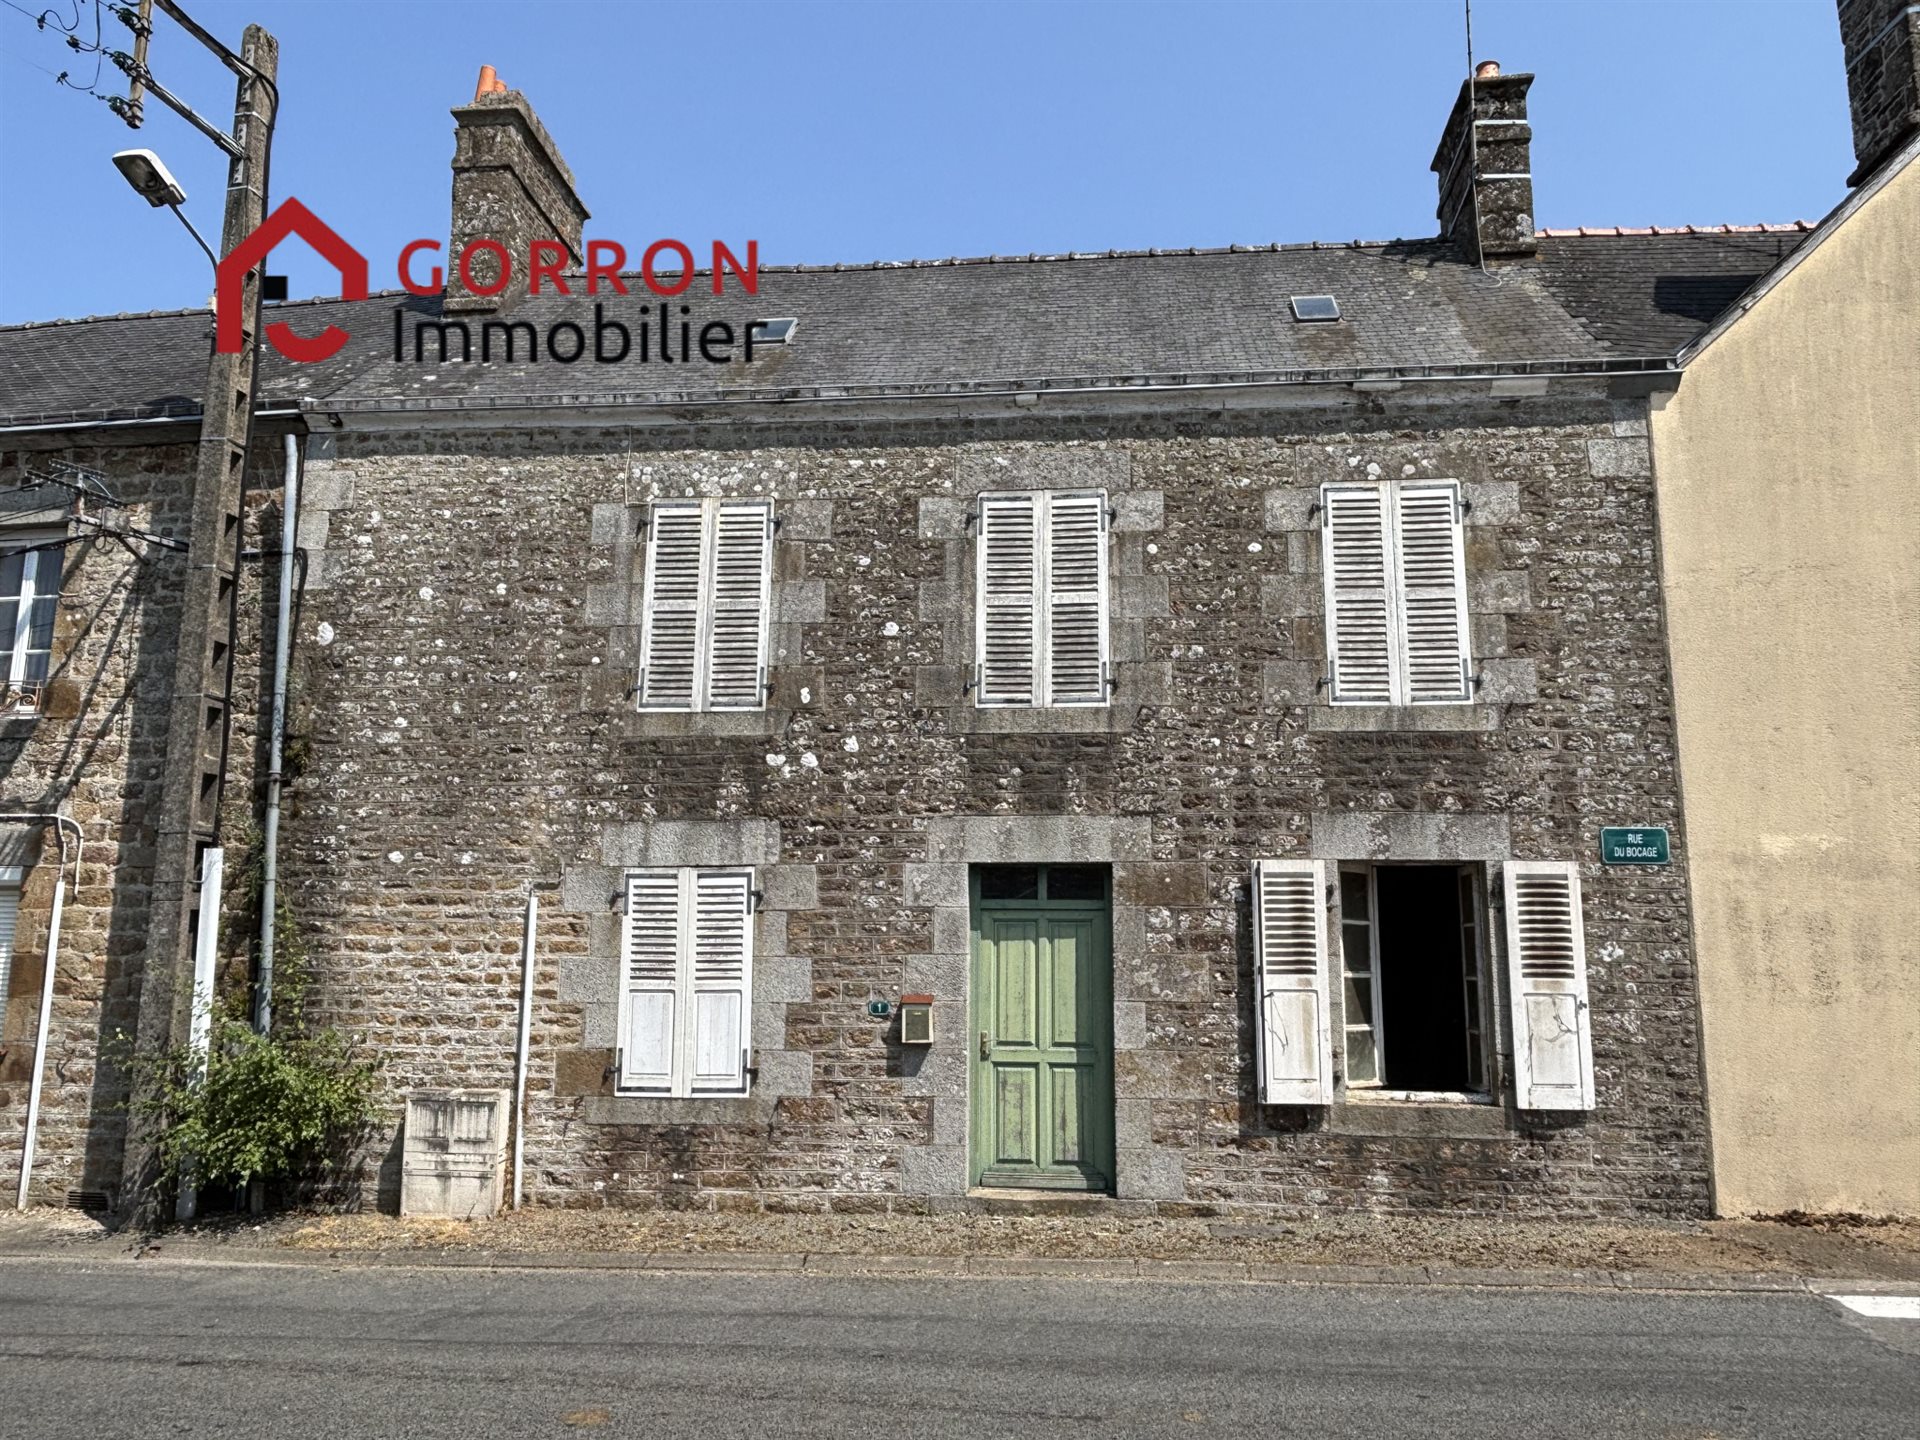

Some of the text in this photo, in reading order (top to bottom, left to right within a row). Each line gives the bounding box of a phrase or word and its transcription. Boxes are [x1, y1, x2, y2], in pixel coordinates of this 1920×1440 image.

[1627, 833, 1643, 844] RUE
[1614, 847, 1658, 857] DU BOCAGE
[877, 1003, 882, 1012] 1
